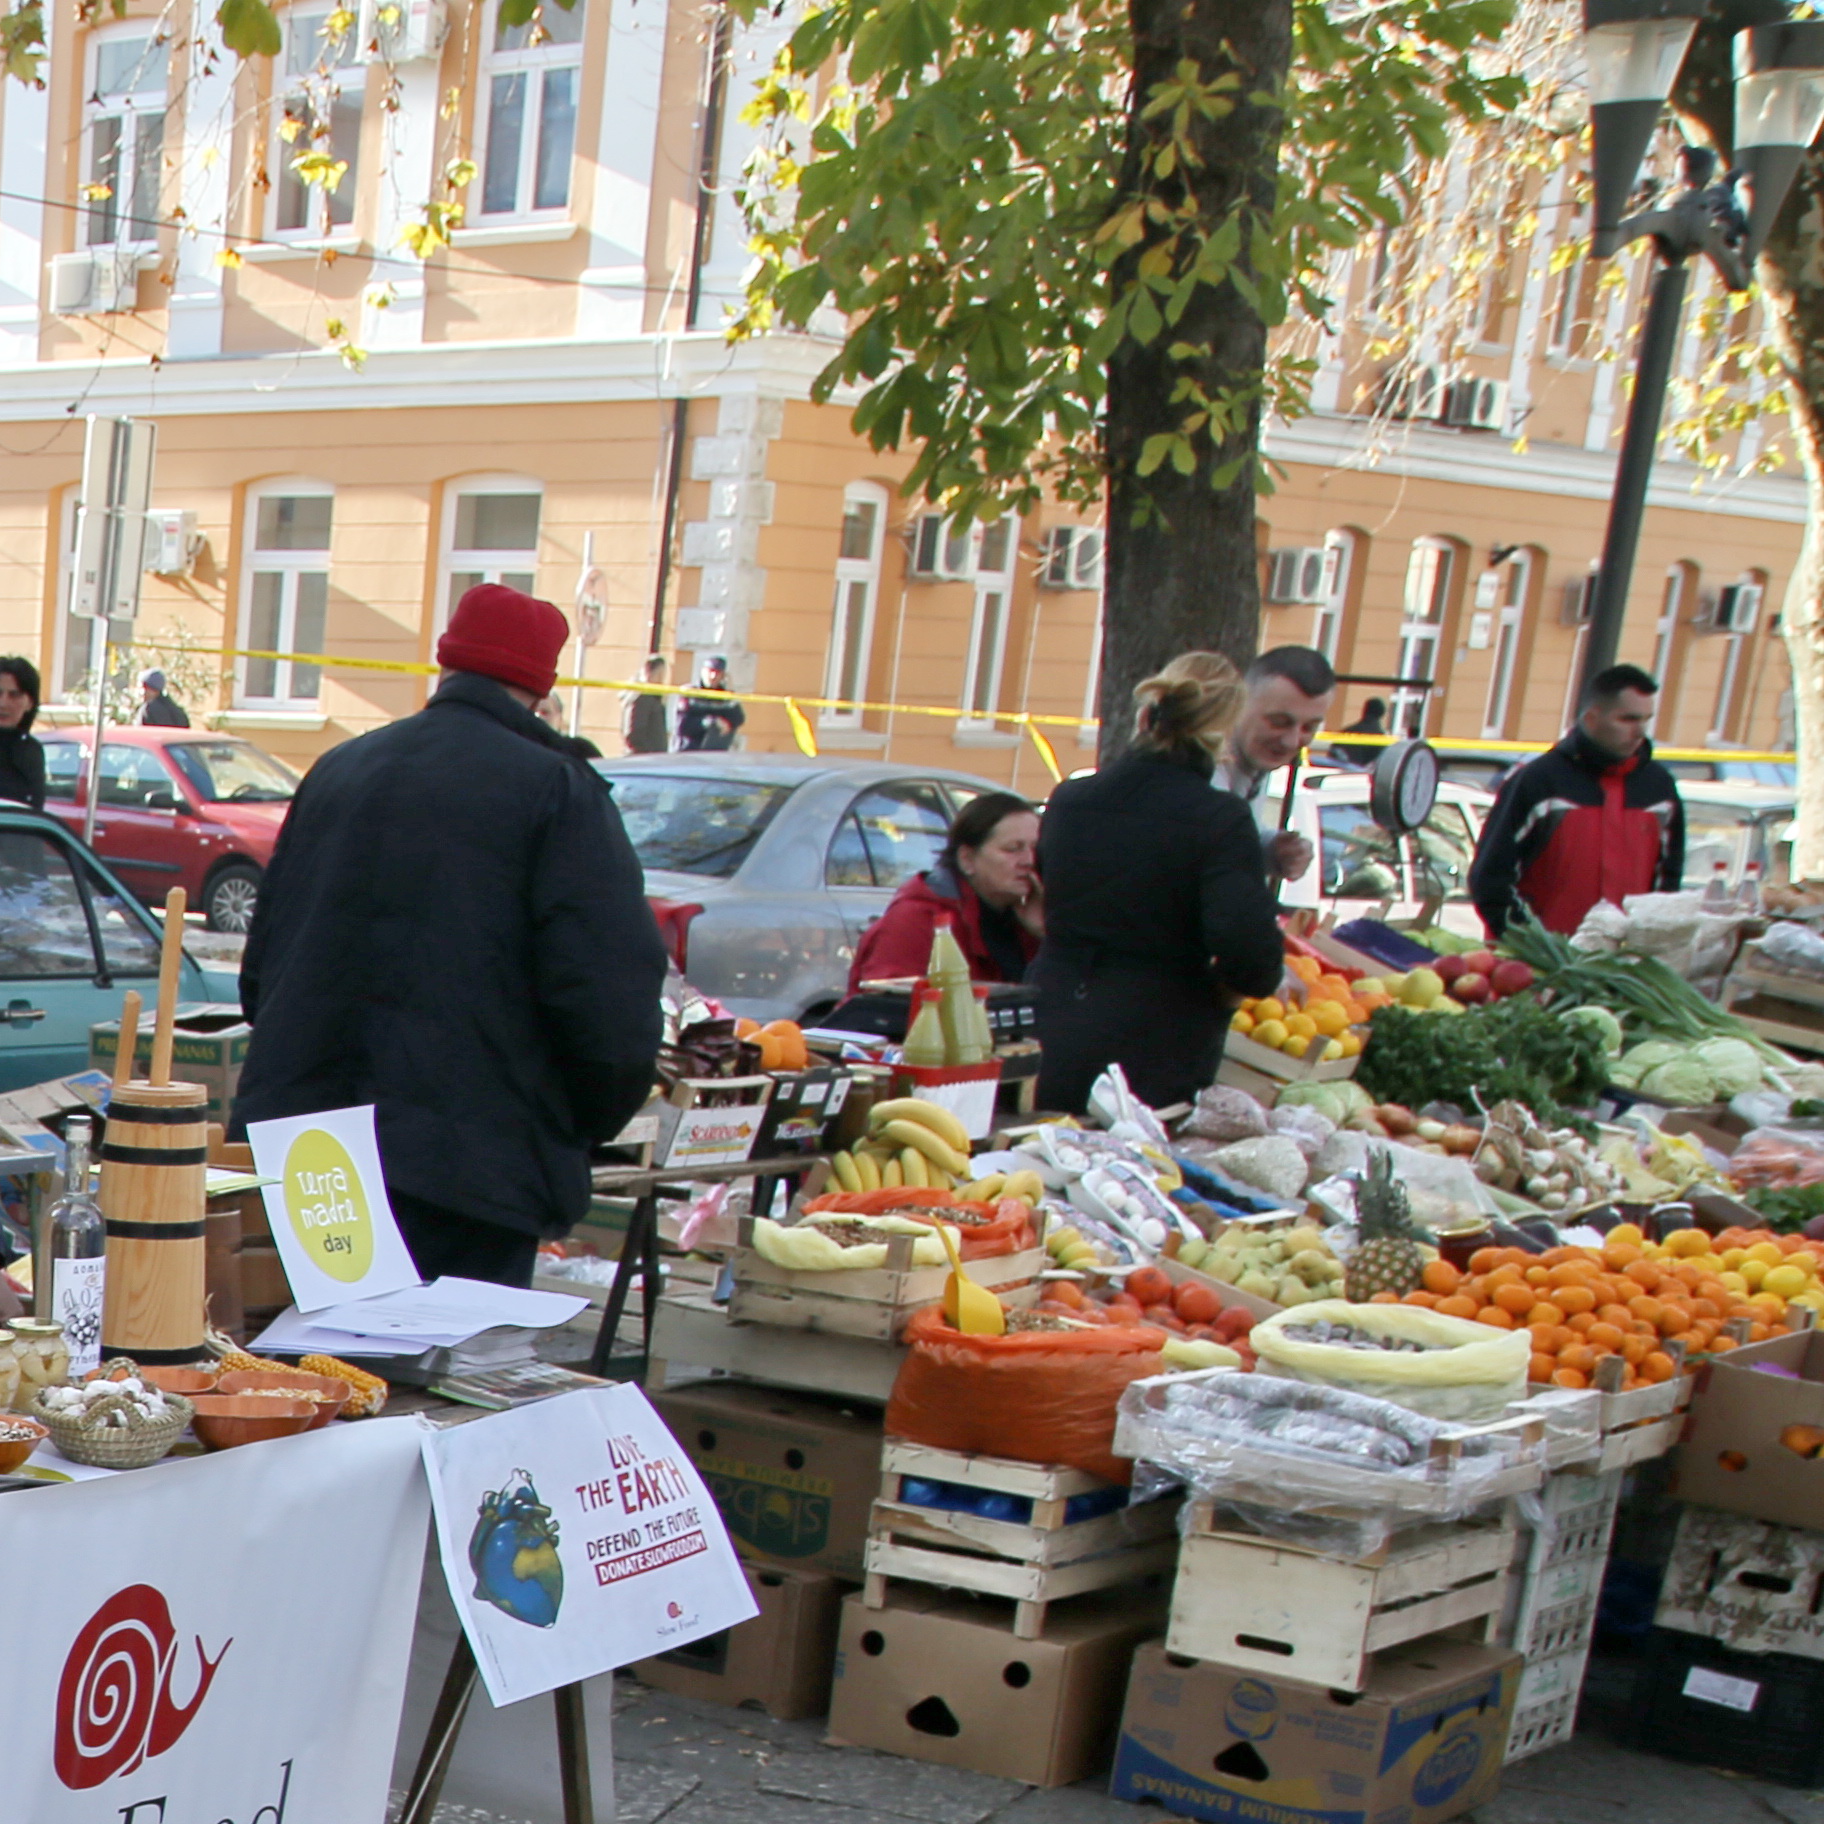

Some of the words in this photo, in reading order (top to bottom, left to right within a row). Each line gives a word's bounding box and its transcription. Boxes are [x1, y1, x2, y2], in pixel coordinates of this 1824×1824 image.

[301, 1192, 358, 1232] madre
[322, 1231, 352, 1256] day
[606, 1434, 645, 1470] LOVE
[575, 1478, 613, 1513] THE
[617, 1456, 690, 1515] EARTH
[586, 1532, 641, 1561] DEFEND
[644, 1521, 666, 1543] THE
[667, 1507, 701, 1535] FUTURE
[1131, 1773, 1234, 1813] BANANAS
